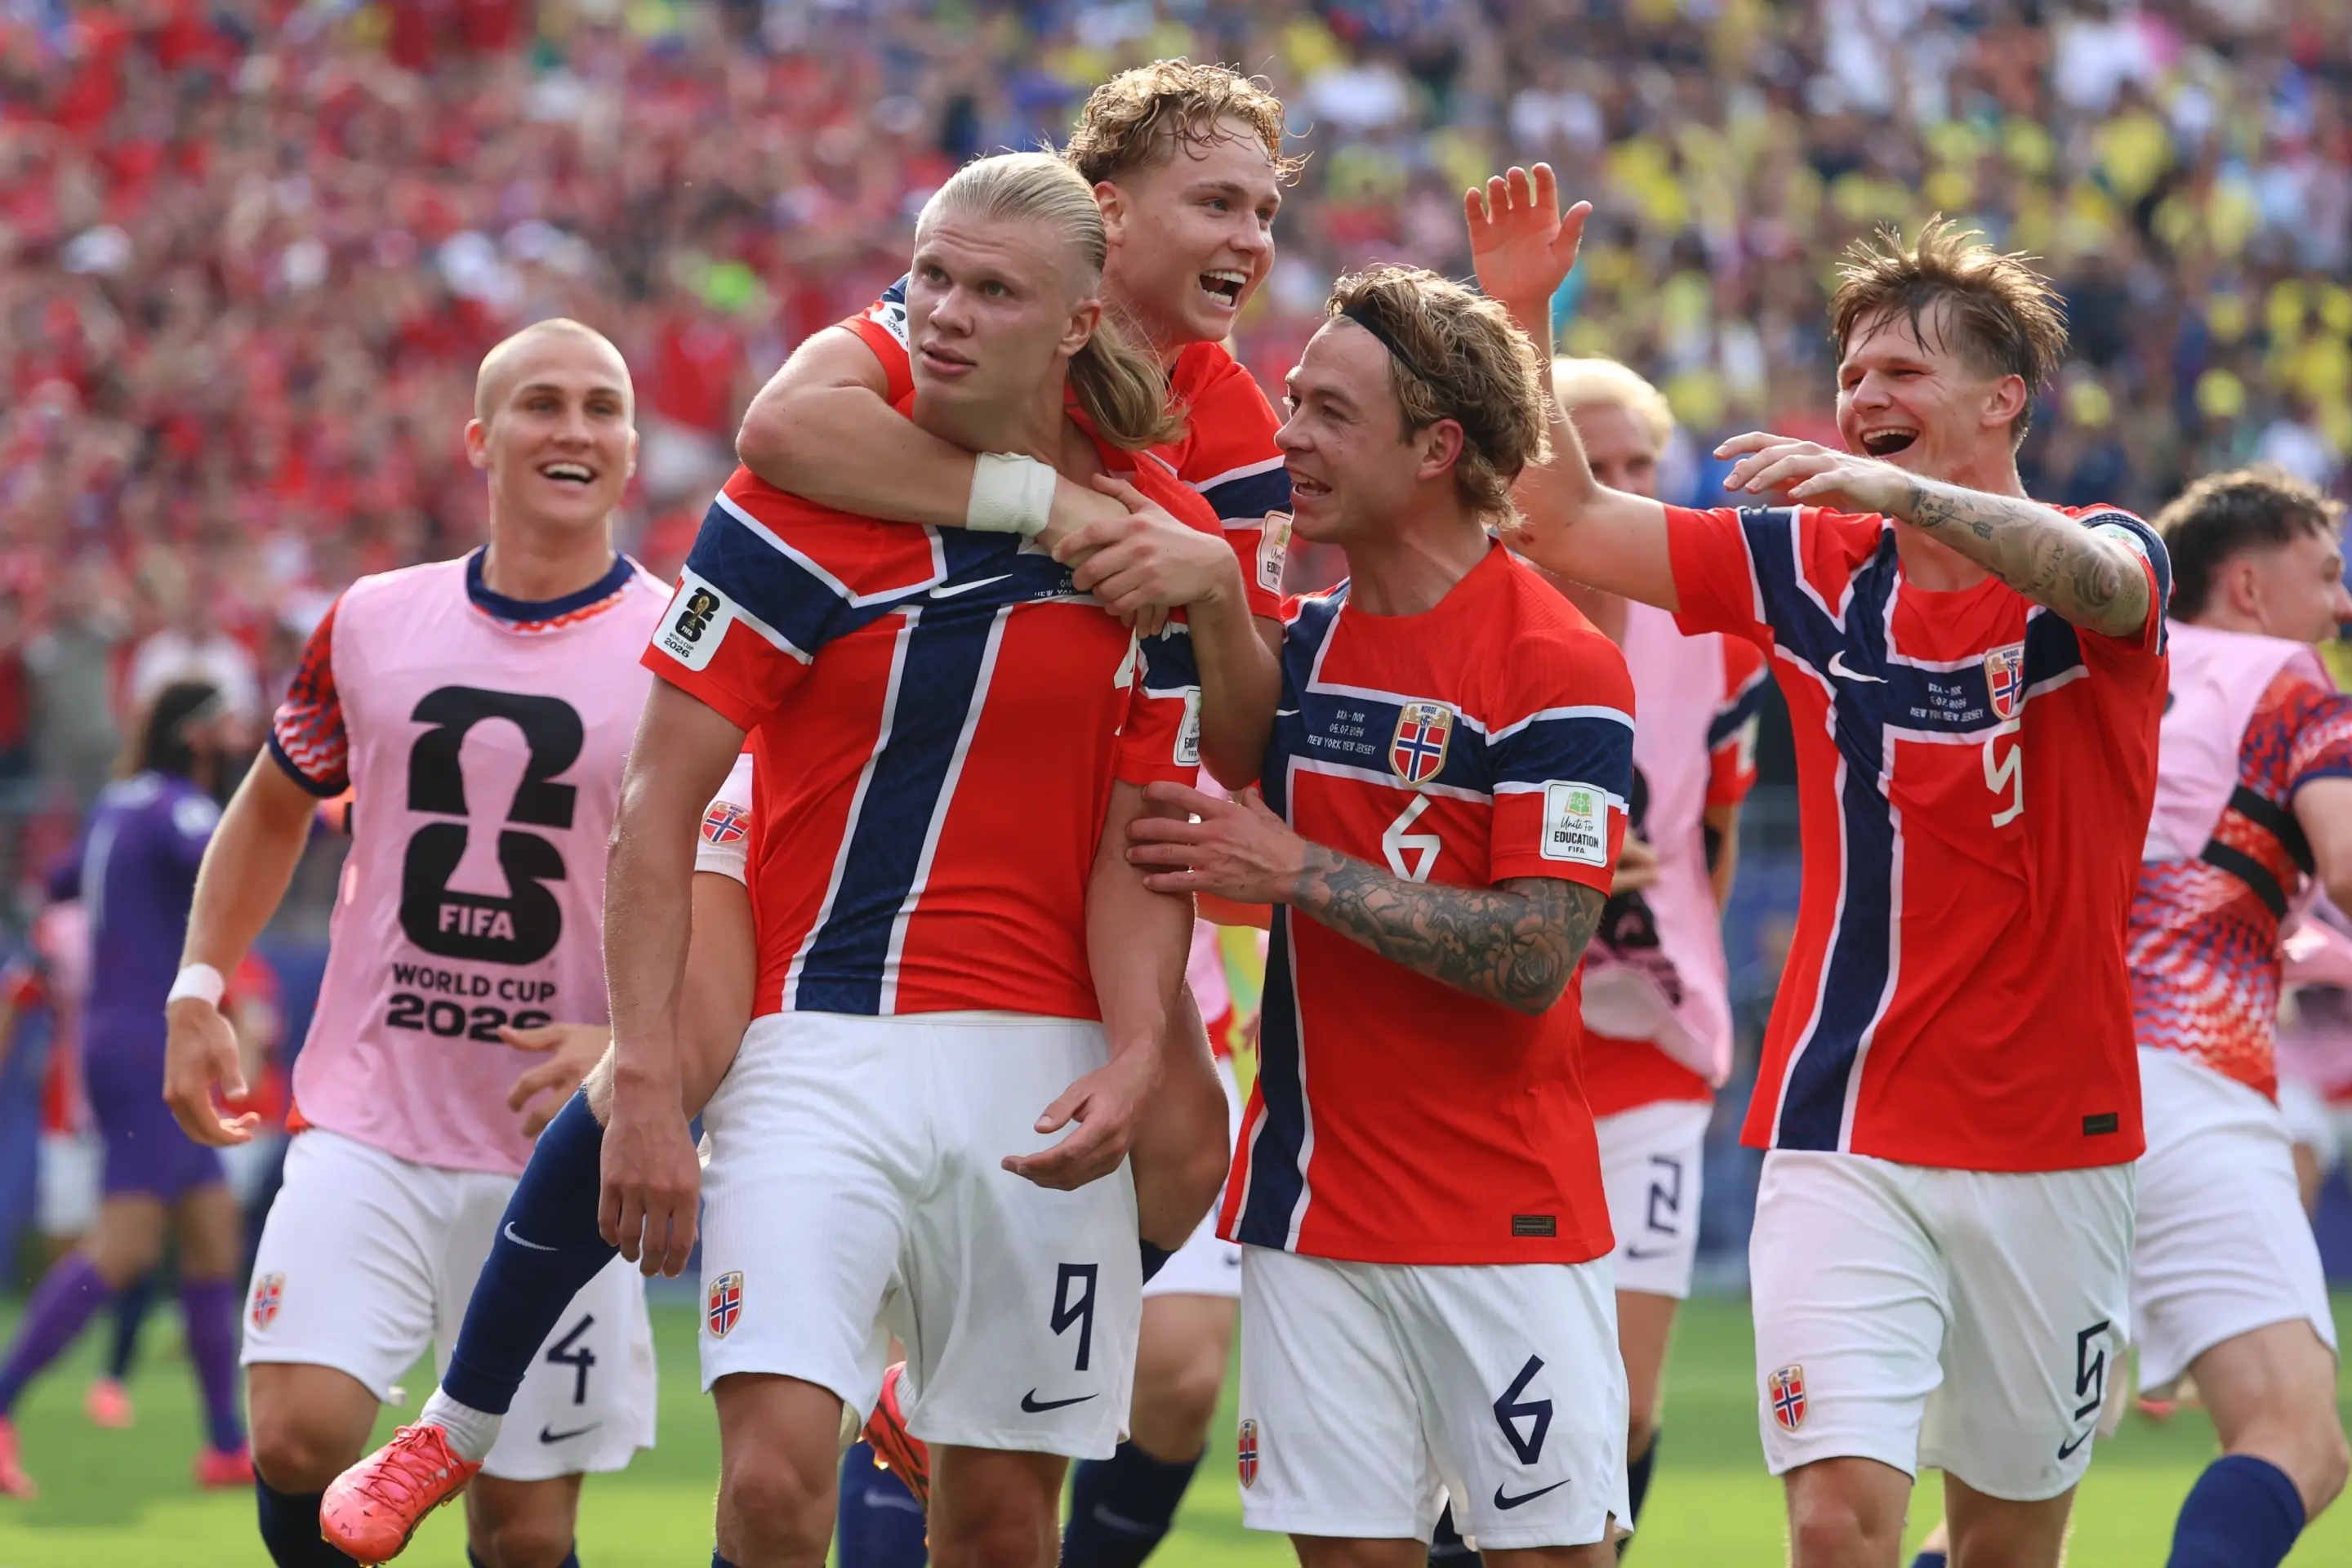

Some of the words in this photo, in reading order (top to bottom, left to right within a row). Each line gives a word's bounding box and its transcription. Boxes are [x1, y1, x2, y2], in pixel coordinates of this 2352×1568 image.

[670, 632, 684, 644] WORLD
[683, 642, 694, 651] CUP
[681, 625, 693, 637] FIFA
[664, 637, 690, 658] 2026
[1336, 710, 1348, 720] BRA
[1352, 712, 1365, 723] NOR
[1421, 705, 1437, 715] NORGE
[1307, 734, 1324, 746] NEW
[1324, 737, 1343, 750] YORK
[1343, 741, 1356, 751] NEW
[1355, 742, 1376, 755] JERSEY
[1982, 717, 2025, 828] 5
[1561, 816, 1584, 831] Unite
[1383, 793, 1441, 884] 6
[1553, 831, 1599, 849] EDUCATION
[1568, 846, 1585, 854] FIFA
[439, 904, 516, 941] FIFA
[392, 963, 491, 997] WORLD
[497, 978, 557, 1003] CUP
[1648, 1155, 1682, 1236] 2
[1050, 1263, 1098, 1371] 9
[546, 1312, 596, 1406] 4
[2075, 1320, 2110, 1421] 5
[1493, 1354, 1553, 1465] 6
